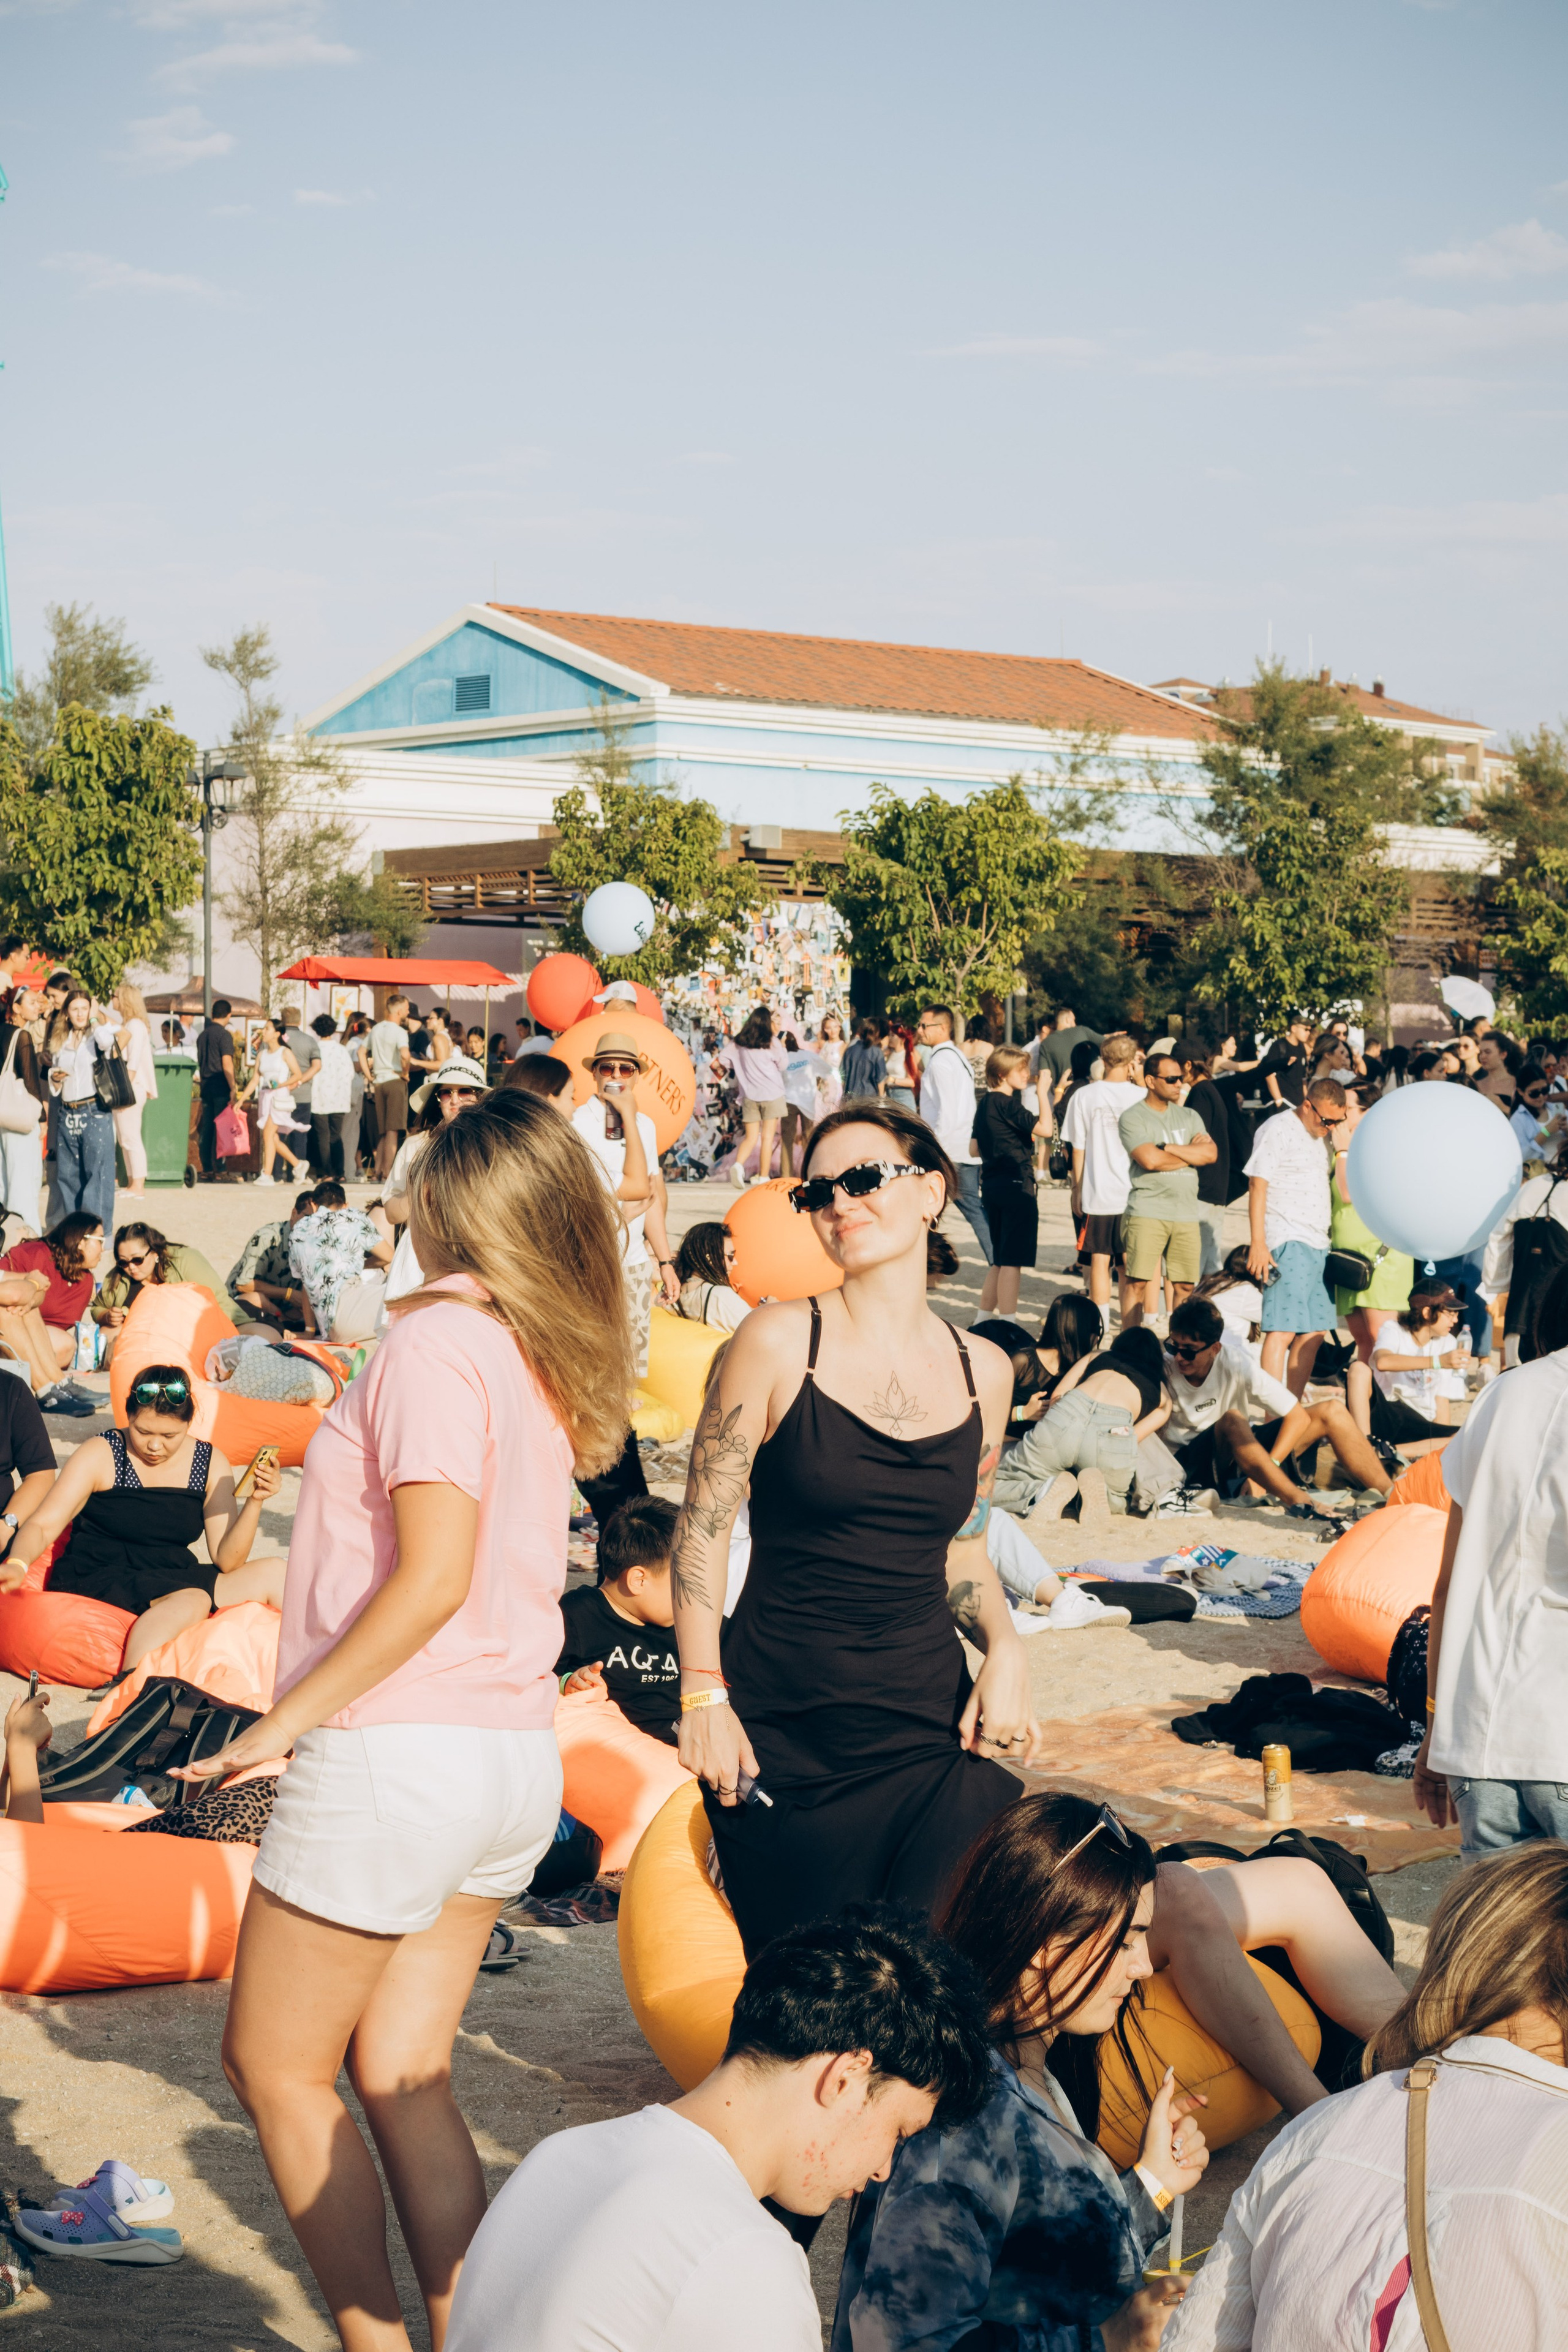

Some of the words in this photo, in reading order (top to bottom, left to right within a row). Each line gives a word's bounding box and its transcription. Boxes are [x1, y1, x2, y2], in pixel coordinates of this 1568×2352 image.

[606, 1645, 679, 1675] AQA
[641, 1674, 660, 1683] EST
[689, 1694, 710, 1705] GUEST
